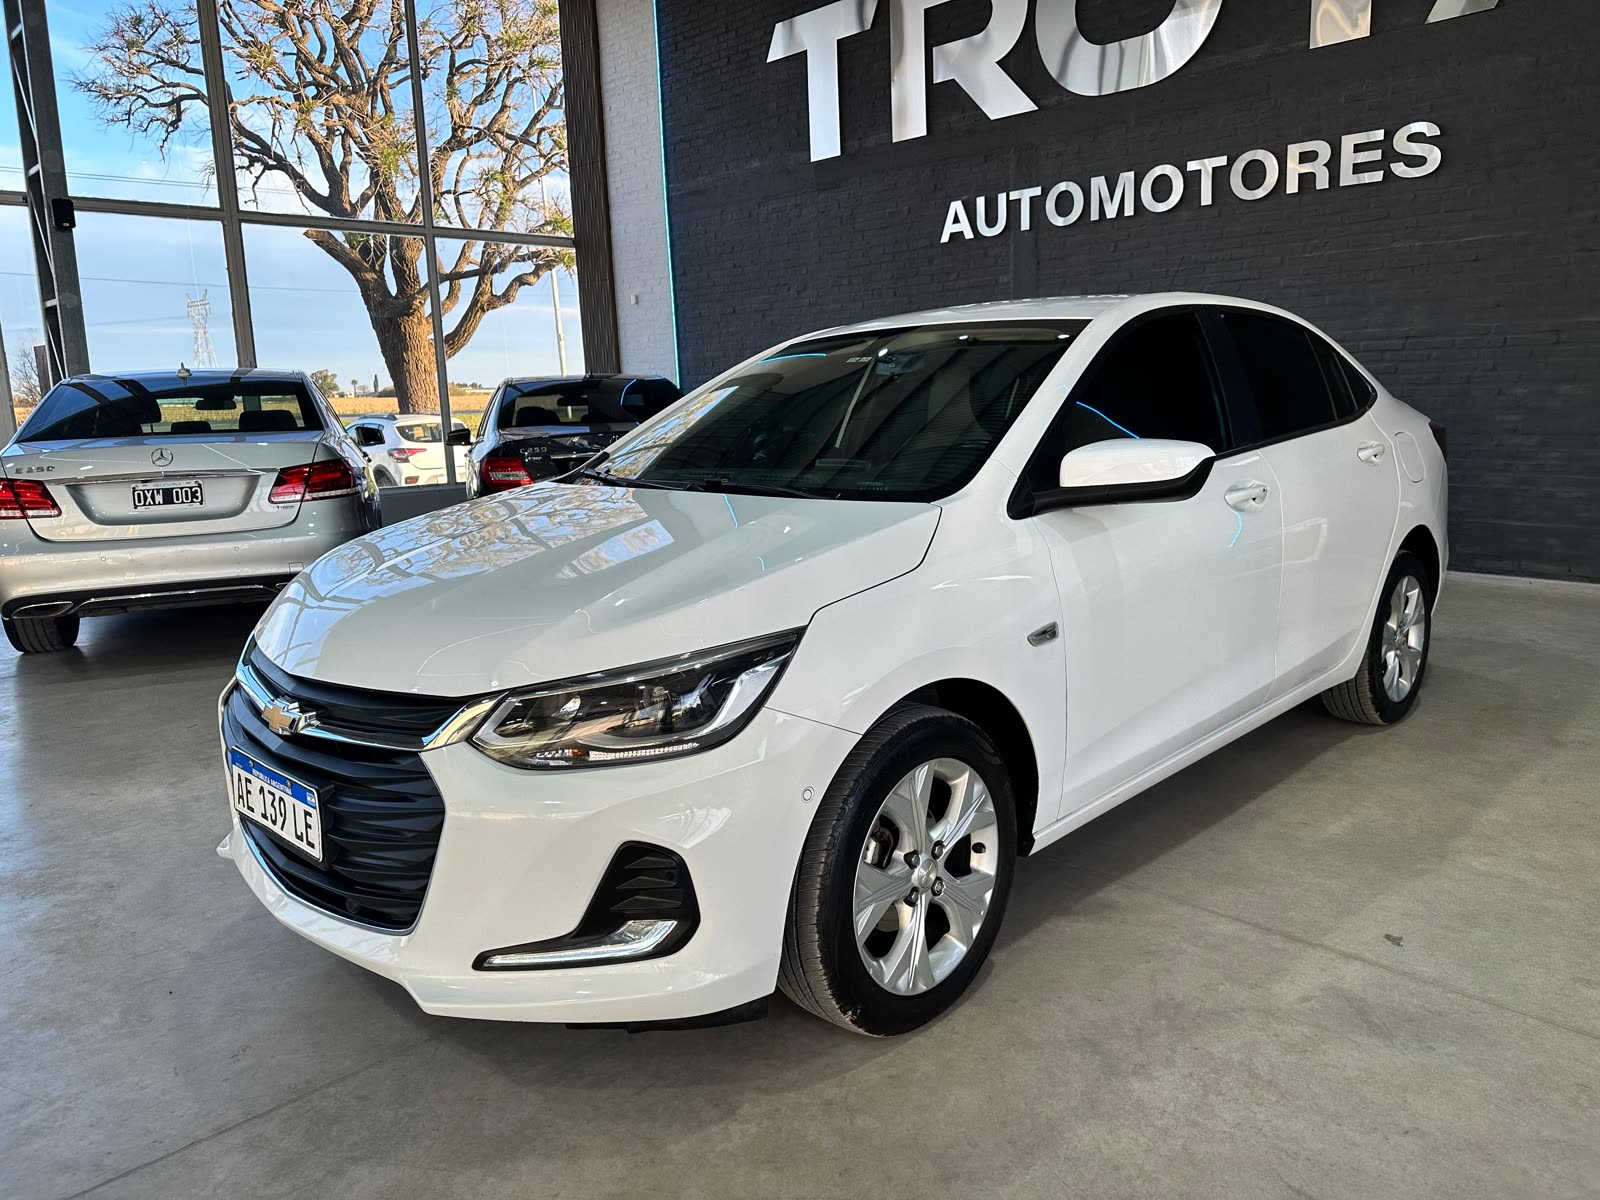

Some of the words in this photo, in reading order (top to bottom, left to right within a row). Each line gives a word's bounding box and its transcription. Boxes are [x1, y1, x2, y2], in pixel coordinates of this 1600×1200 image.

[767, 0, 1500, 162] TRO
[939, 121, 1442, 243] AUTOMOTORES
[134, 489, 164, 506] OXW
[172, 487, 202, 504] 003
[237, 772, 255, 814] AE
[258, 785, 287, 832] 139
[292, 802, 316, 850] LE
